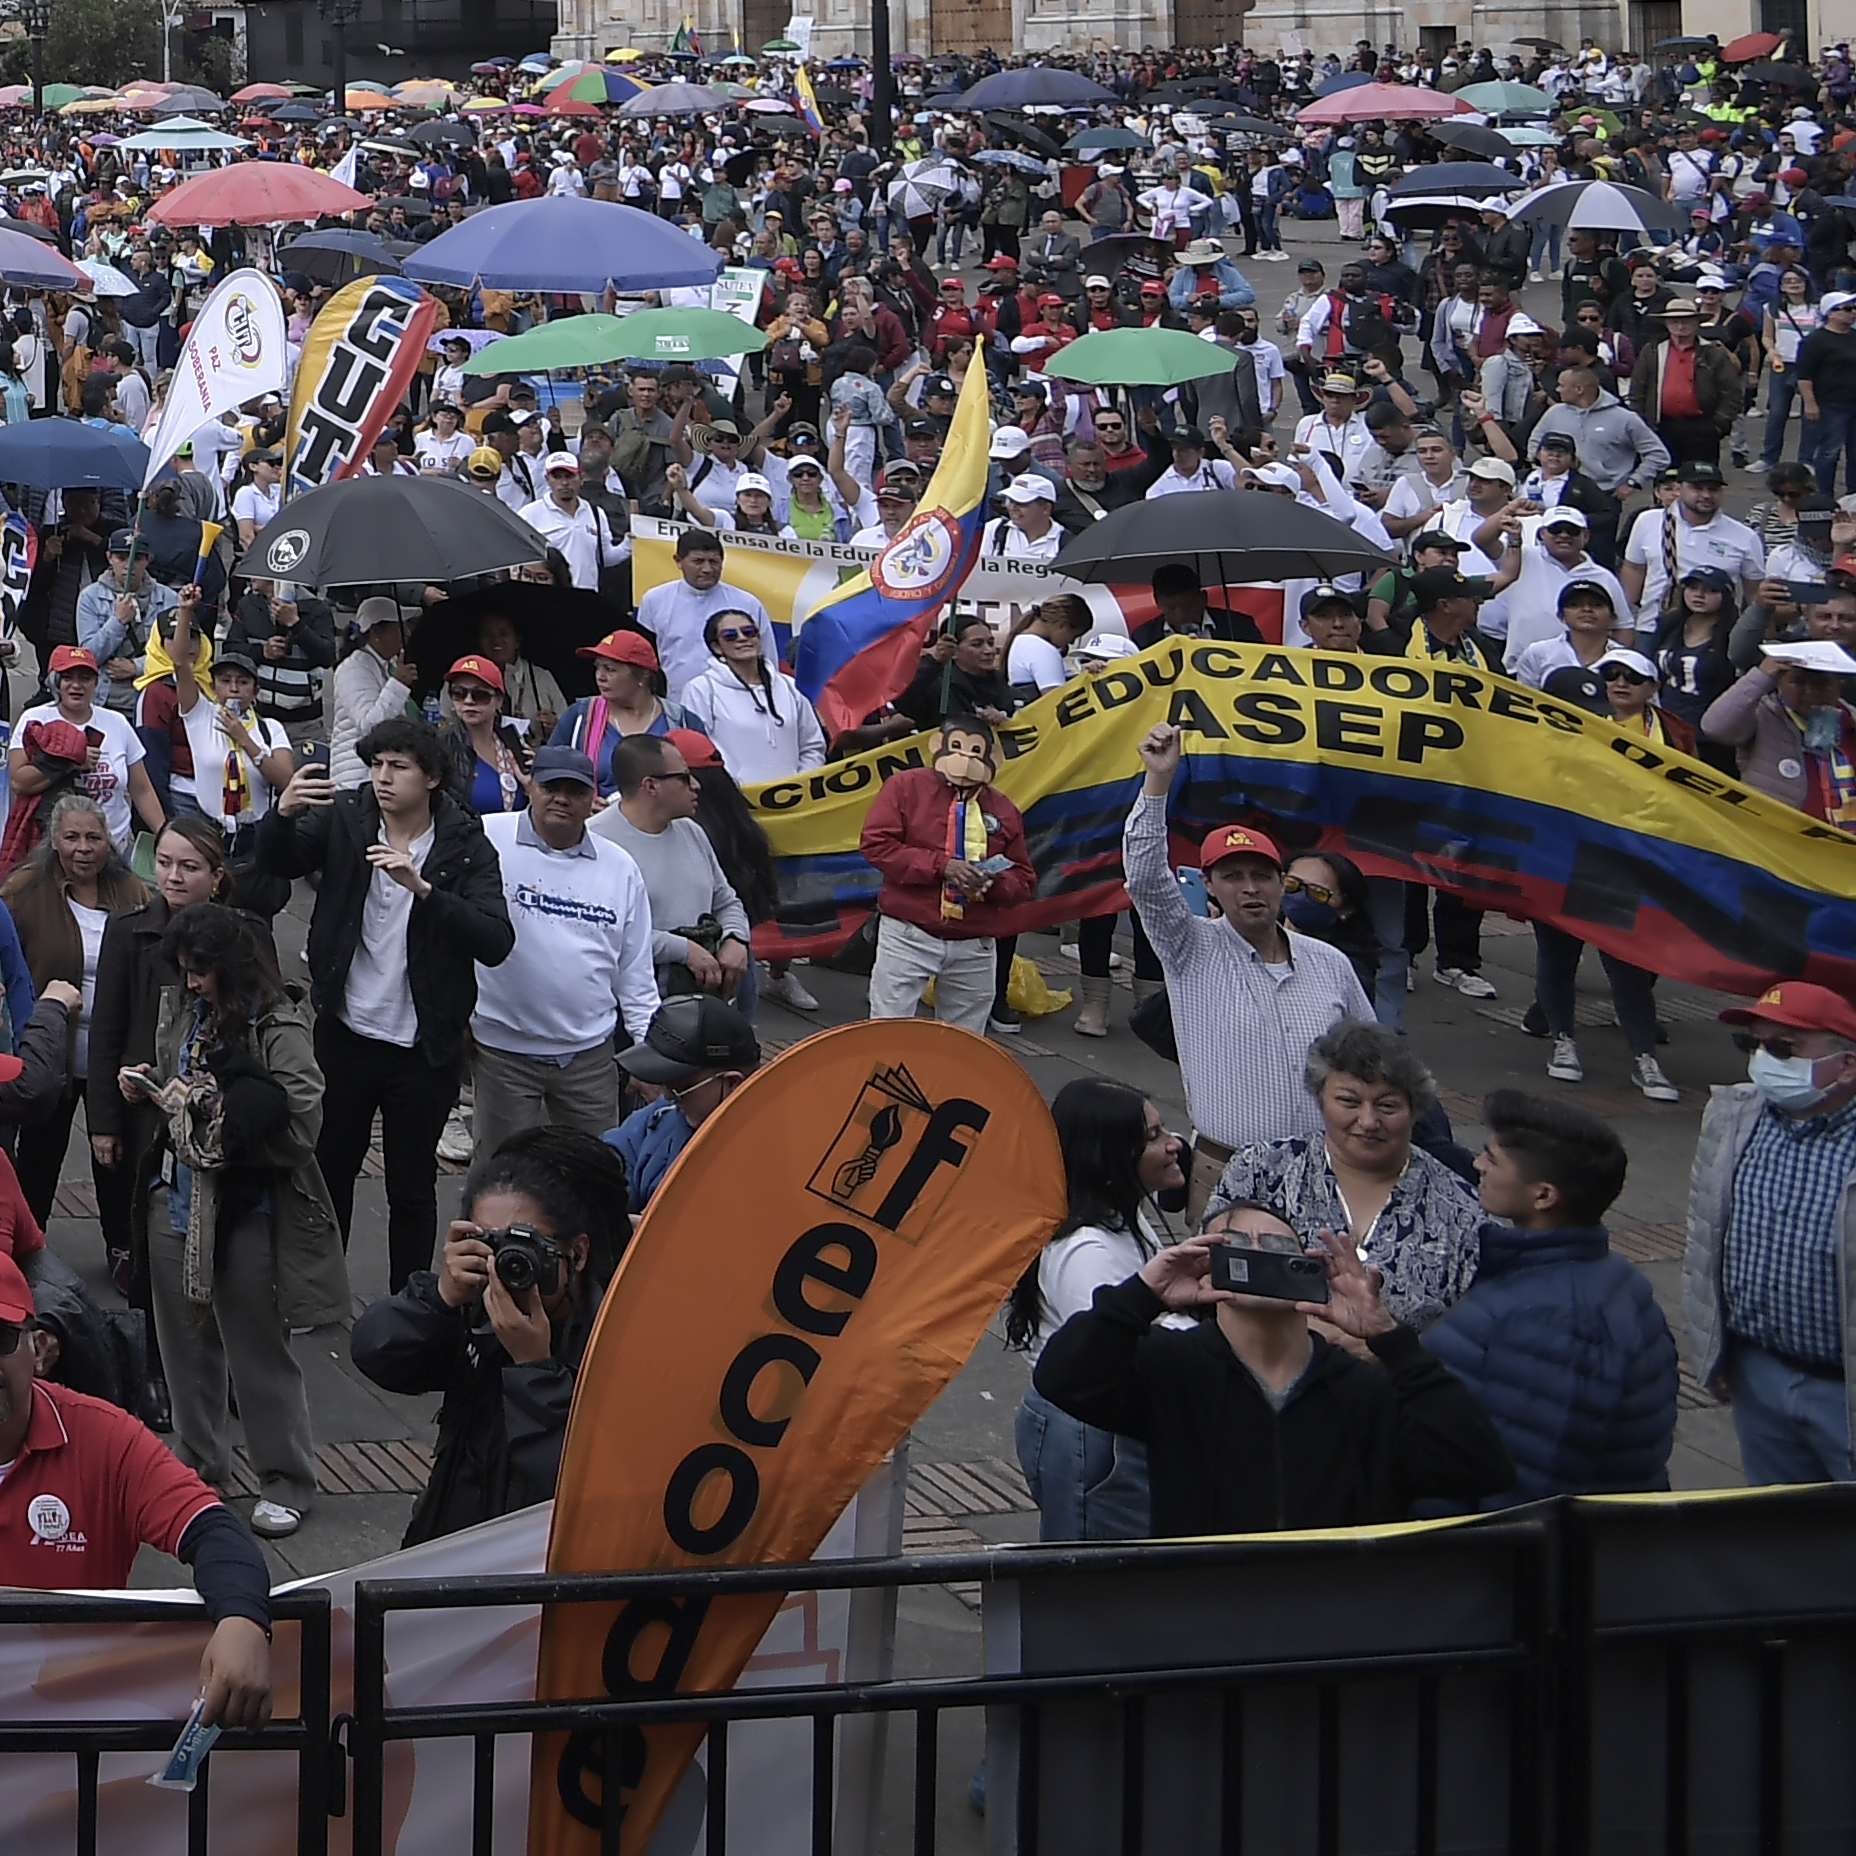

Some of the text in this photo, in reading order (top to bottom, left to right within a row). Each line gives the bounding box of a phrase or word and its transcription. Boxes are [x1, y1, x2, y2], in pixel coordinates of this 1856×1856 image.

[188, 340, 212, 414] SOBERANIA
[208, 345, 222, 373] PAZ
[291, 285, 420, 487] CUT
[657, 520, 679, 537] En
[774, 535, 799, 553] de
[805, 540, 821, 558] la
[831, 544, 882, 564] Educ
[982, 557, 1003, 574] la
[746, 746, 925, 811] CIÓN
[996, 725, 1039, 760] E
[1056, 647, 1583, 734] EDUCADORES
[1165, 690, 1465, 766] ASEP
[517, 889, 615, 921] Champion
